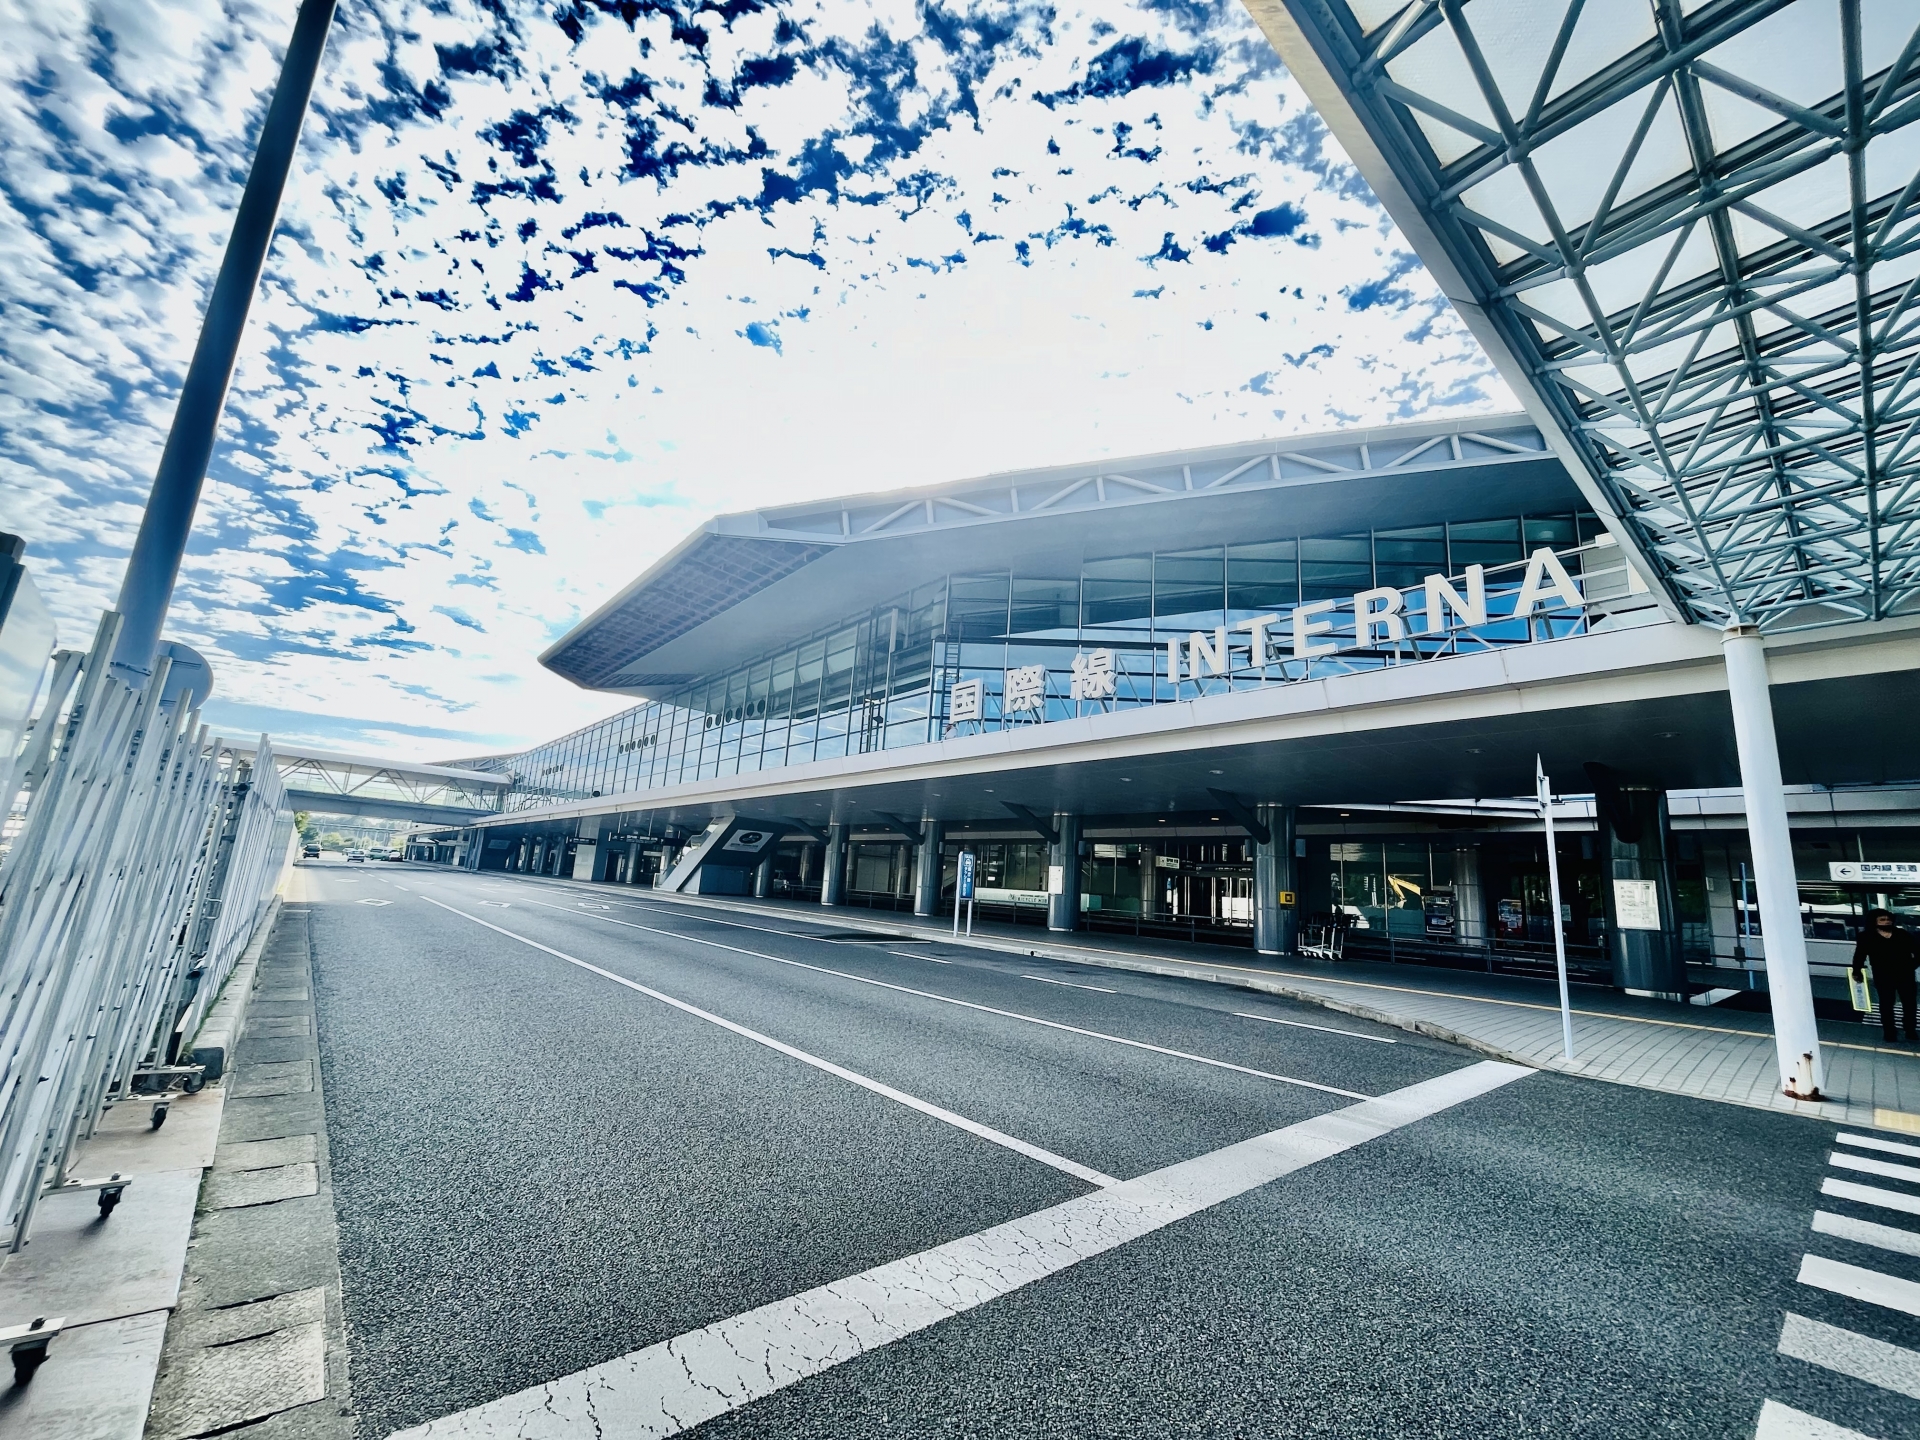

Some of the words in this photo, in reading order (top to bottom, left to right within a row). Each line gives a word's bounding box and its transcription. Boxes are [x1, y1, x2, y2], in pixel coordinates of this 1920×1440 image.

[950, 647, 1117, 724] 国際線
[1860, 864, 1892, 872] 国内線
